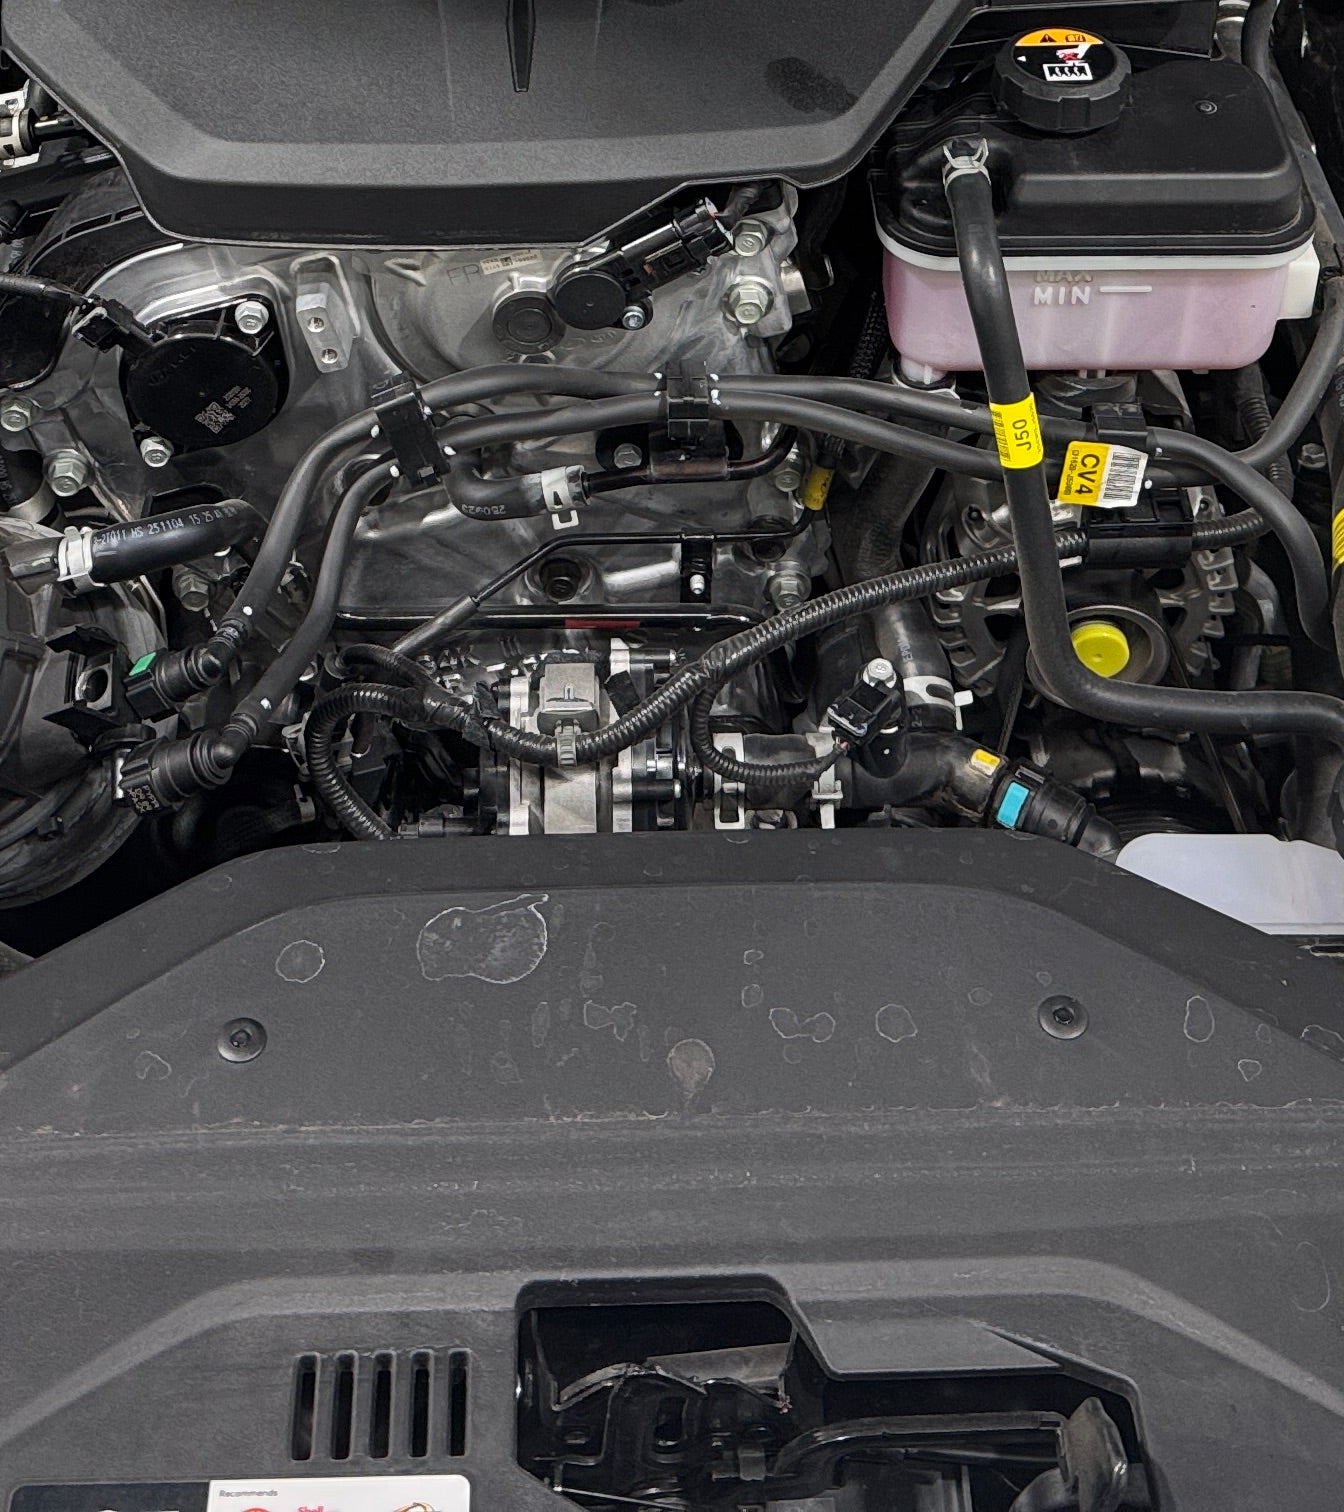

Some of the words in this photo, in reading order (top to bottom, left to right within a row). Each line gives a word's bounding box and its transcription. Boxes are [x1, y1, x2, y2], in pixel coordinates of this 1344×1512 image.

[1034, 285, 1091, 306] MIN
[1012, 418, 1032, 451] J50
[1075, 453, 1101, 495] CV4
[147, 518, 185, 535] 251104
[219, 1489, 278, 1498] Recommends
